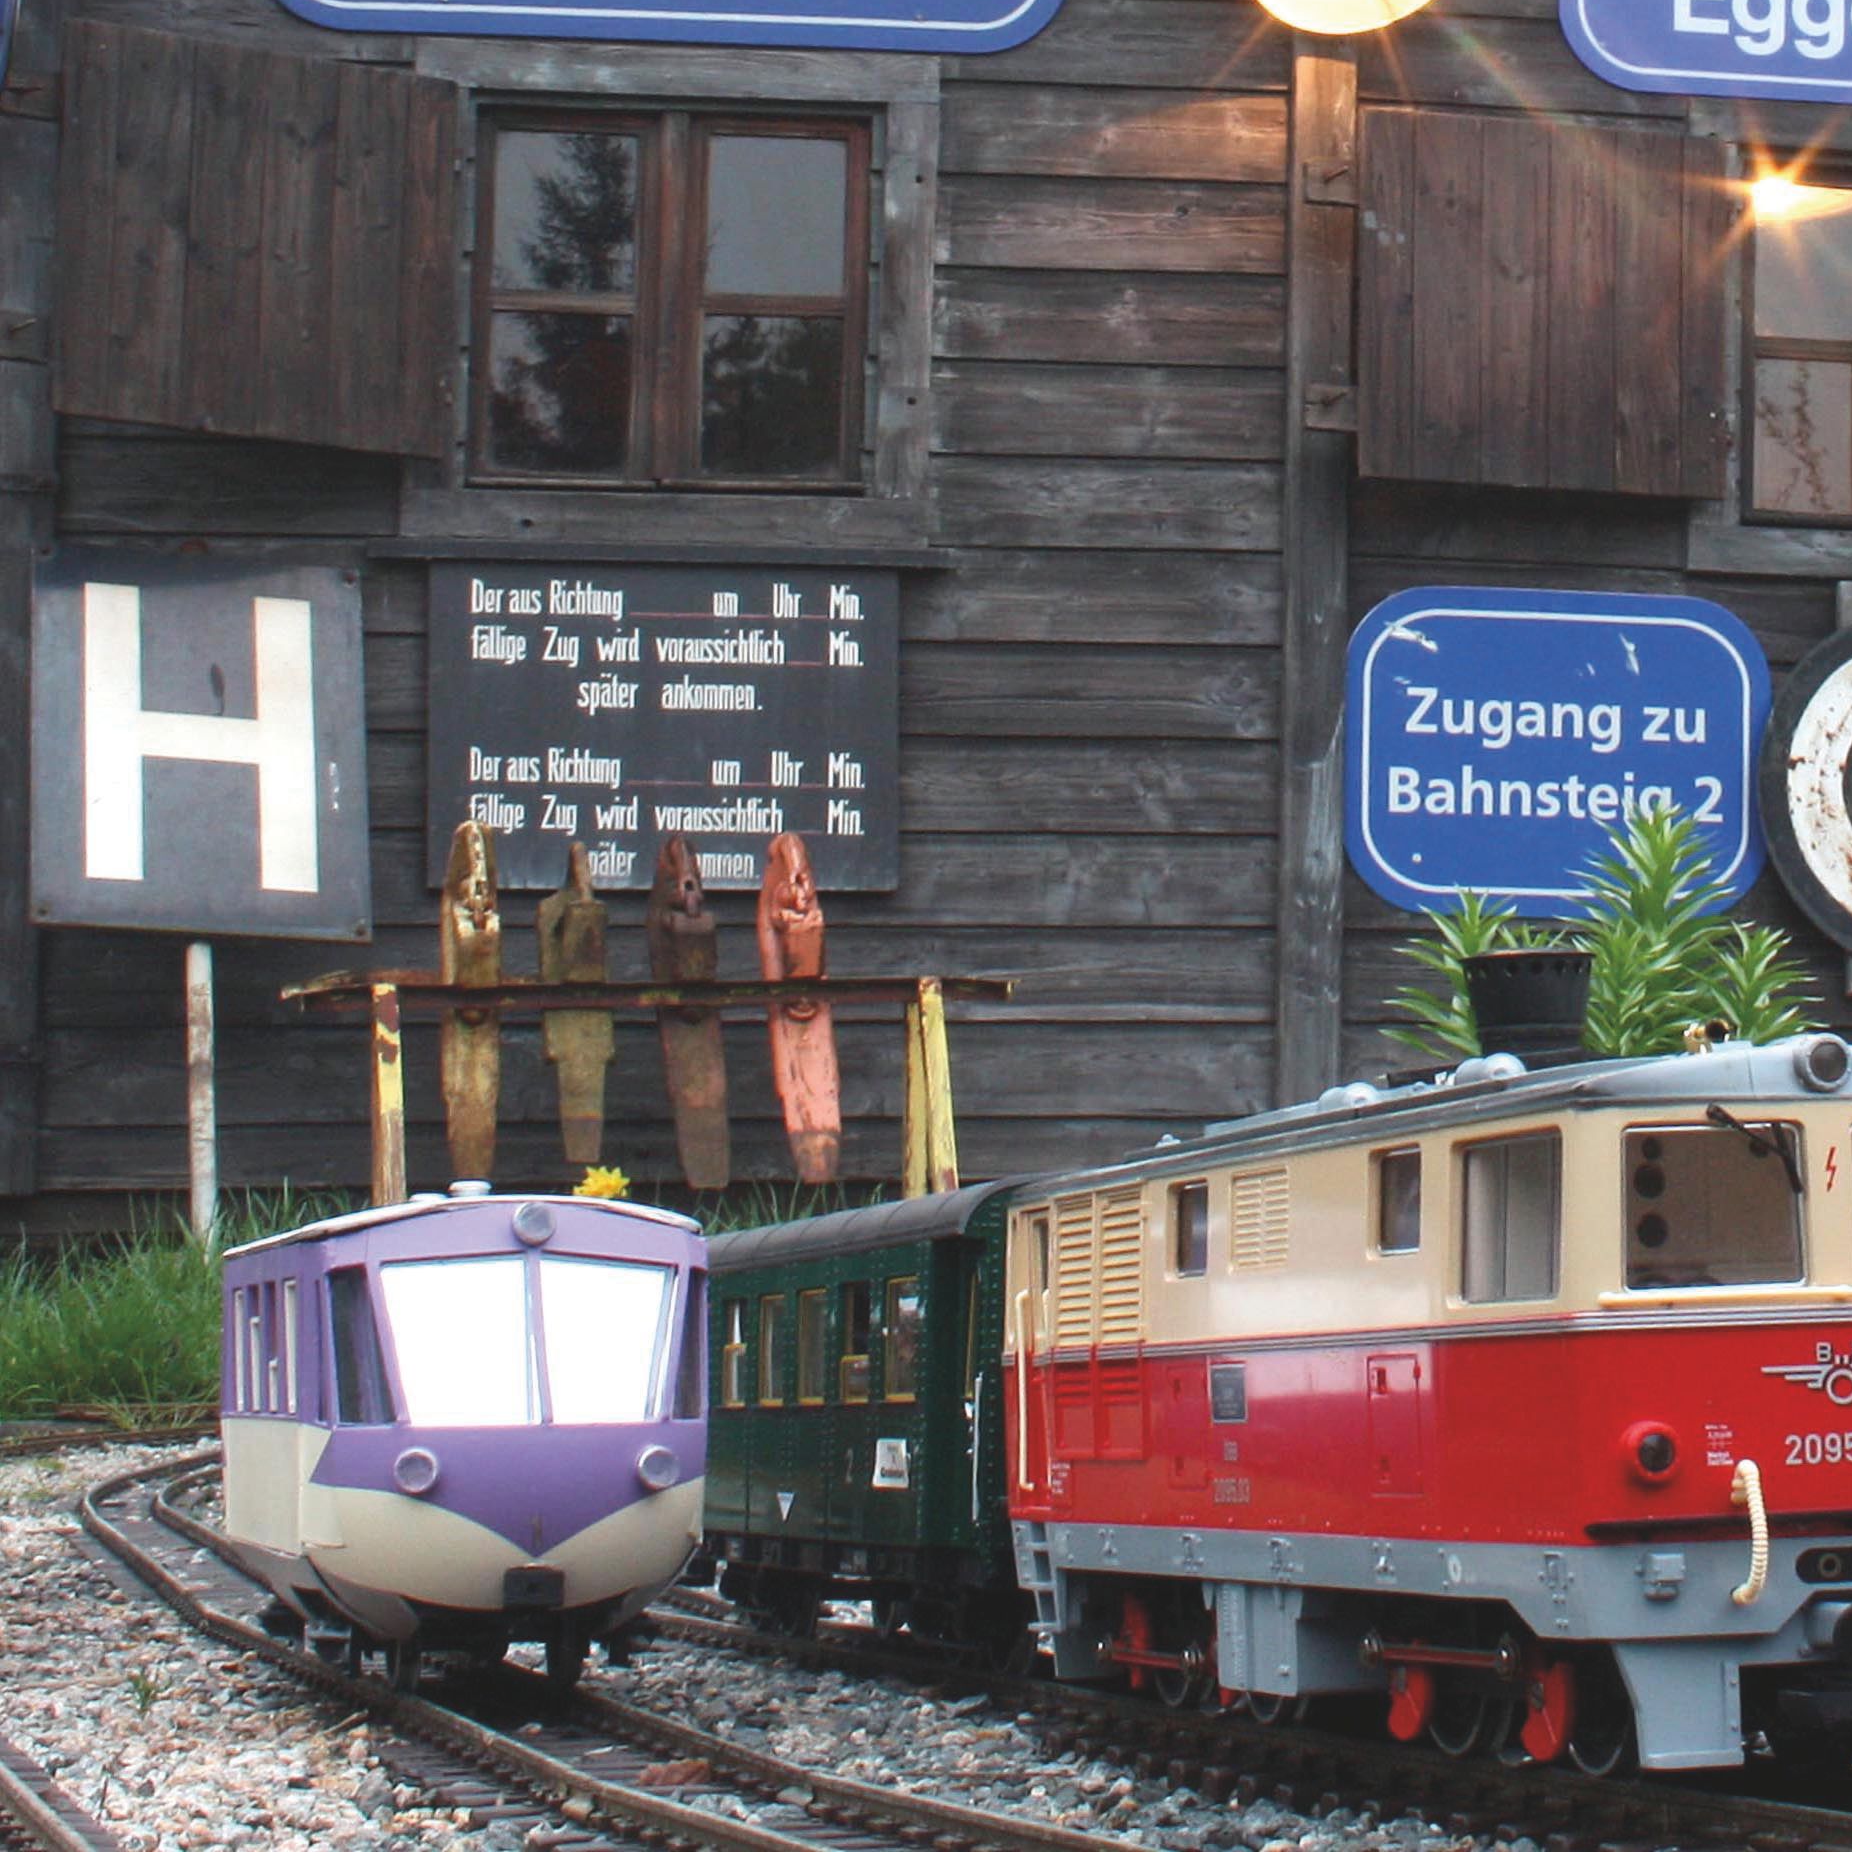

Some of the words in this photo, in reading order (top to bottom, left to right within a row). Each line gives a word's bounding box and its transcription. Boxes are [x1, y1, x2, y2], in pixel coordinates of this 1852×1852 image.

[471, 578, 502, 614] Der
[508, 588, 542, 614] aus
[549, 579, 623, 620] Richtung
[713, 592, 739, 617] um
[773, 583, 801, 618] Uhr
[829, 584, 864, 620] Min.
[471, 625, 527, 665] fällige
[542, 626, 580, 667] Zug
[597, 627, 640, 662] wird
[655, 629, 785, 664] voraussichtlich
[829, 631, 864, 666] Min.
[577, 672, 640, 716] später
[661, 674, 763, 711] ankommen.
[84, 581, 318, 893] H
[1405, 686, 1621, 753] Zugang
[1642, 705, 1706, 743] zu
[469, 747, 502, 781] Der
[506, 756, 540, 782] aus
[548, 748, 621, 789] Richtung
[711, 760, 741, 785] um
[771, 751, 804, 786] Uhr
[827, 752, 866, 788] Min.
[469, 793, 526, 834] fällige
[540, 794, 577, 836] Zug
[595, 796, 638, 830] wird
[654, 798, 784, 833] voraussichtlich
[827, 799, 865, 835] Min.
[1388, 764, 1672, 825] Bahnsteig
[1692, 775, 1724, 823] 2
[588, 842, 638, 876] päter
